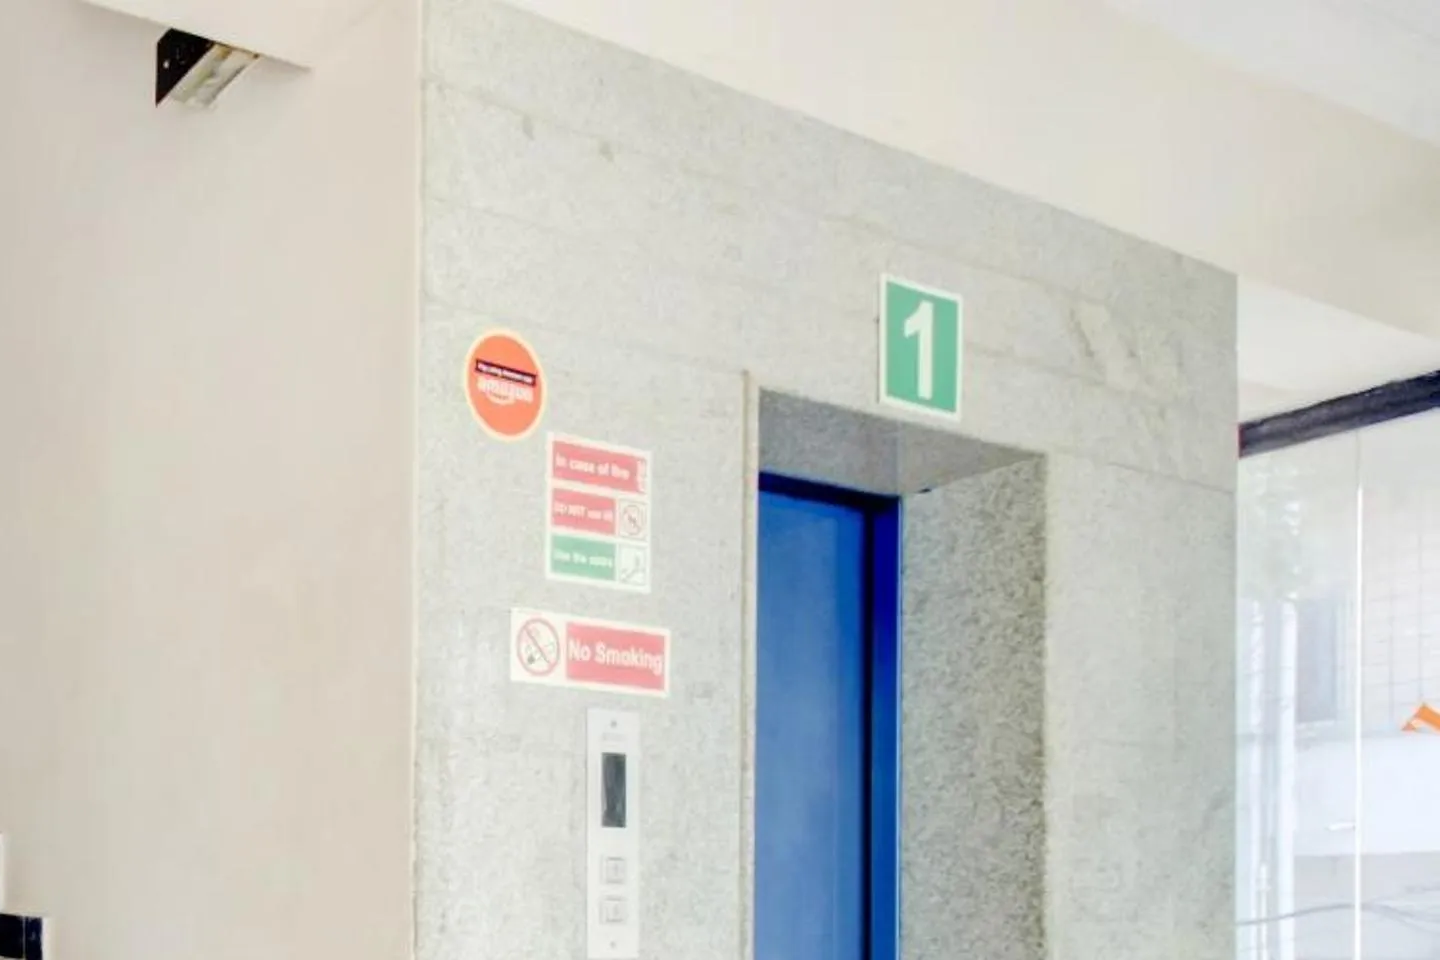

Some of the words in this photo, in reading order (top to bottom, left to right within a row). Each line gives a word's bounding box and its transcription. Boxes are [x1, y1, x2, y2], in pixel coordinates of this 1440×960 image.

[903, 299, 933, 400] 1
[568, 637, 592, 661] No
[595, 640, 662, 676] Smoking
